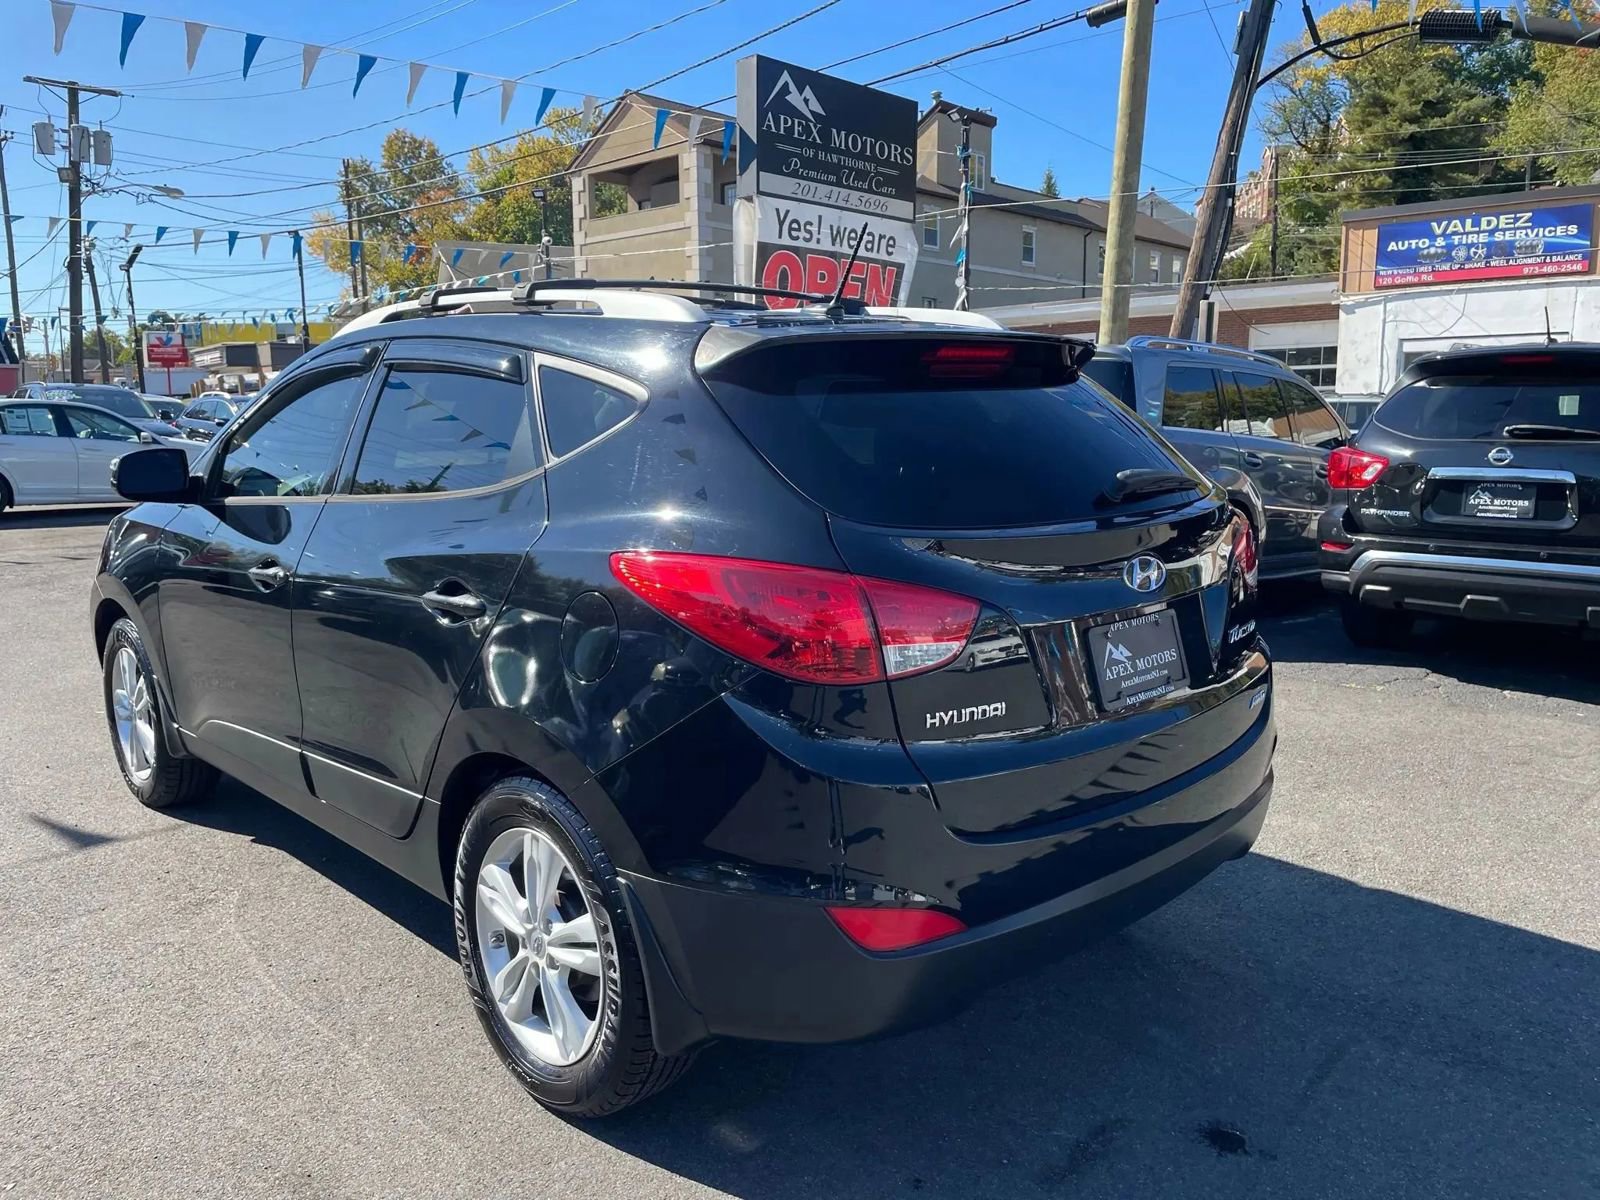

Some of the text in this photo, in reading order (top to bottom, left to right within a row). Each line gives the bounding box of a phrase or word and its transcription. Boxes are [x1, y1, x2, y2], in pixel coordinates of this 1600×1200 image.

[762, 112, 914, 166] APEX MOTORS
[803, 147, 877, 173] OF HAWTHORNE
[782, 158, 896, 195] Premium Used Cars
[791, 182, 888, 212] 201.414.5696
[775, 207, 896, 257] Yes! we are
[1431, 212, 1533, 235] VALDEZ
[1387, 224, 1578, 252] AUTO & TIRE SERVICES
[1416, 265, 1432, 273] TIRES
[1490, 259, 1507, 267] WEEL
[1509, 256, 1545, 265] ALIGNMENT
[1552, 254, 1582, 263] BALANCE
[1523, 263, 1582, 274] 973-460-2546
[762, 250, 897, 310] OPEN
[1494, 499, 1528, 507] MOTORS
[1108, 613, 1160, 633] APEX MOTORS
[1105, 649, 1177, 681] APEX MOTORS
[926, 701, 1006, 729] HYUNDAI
